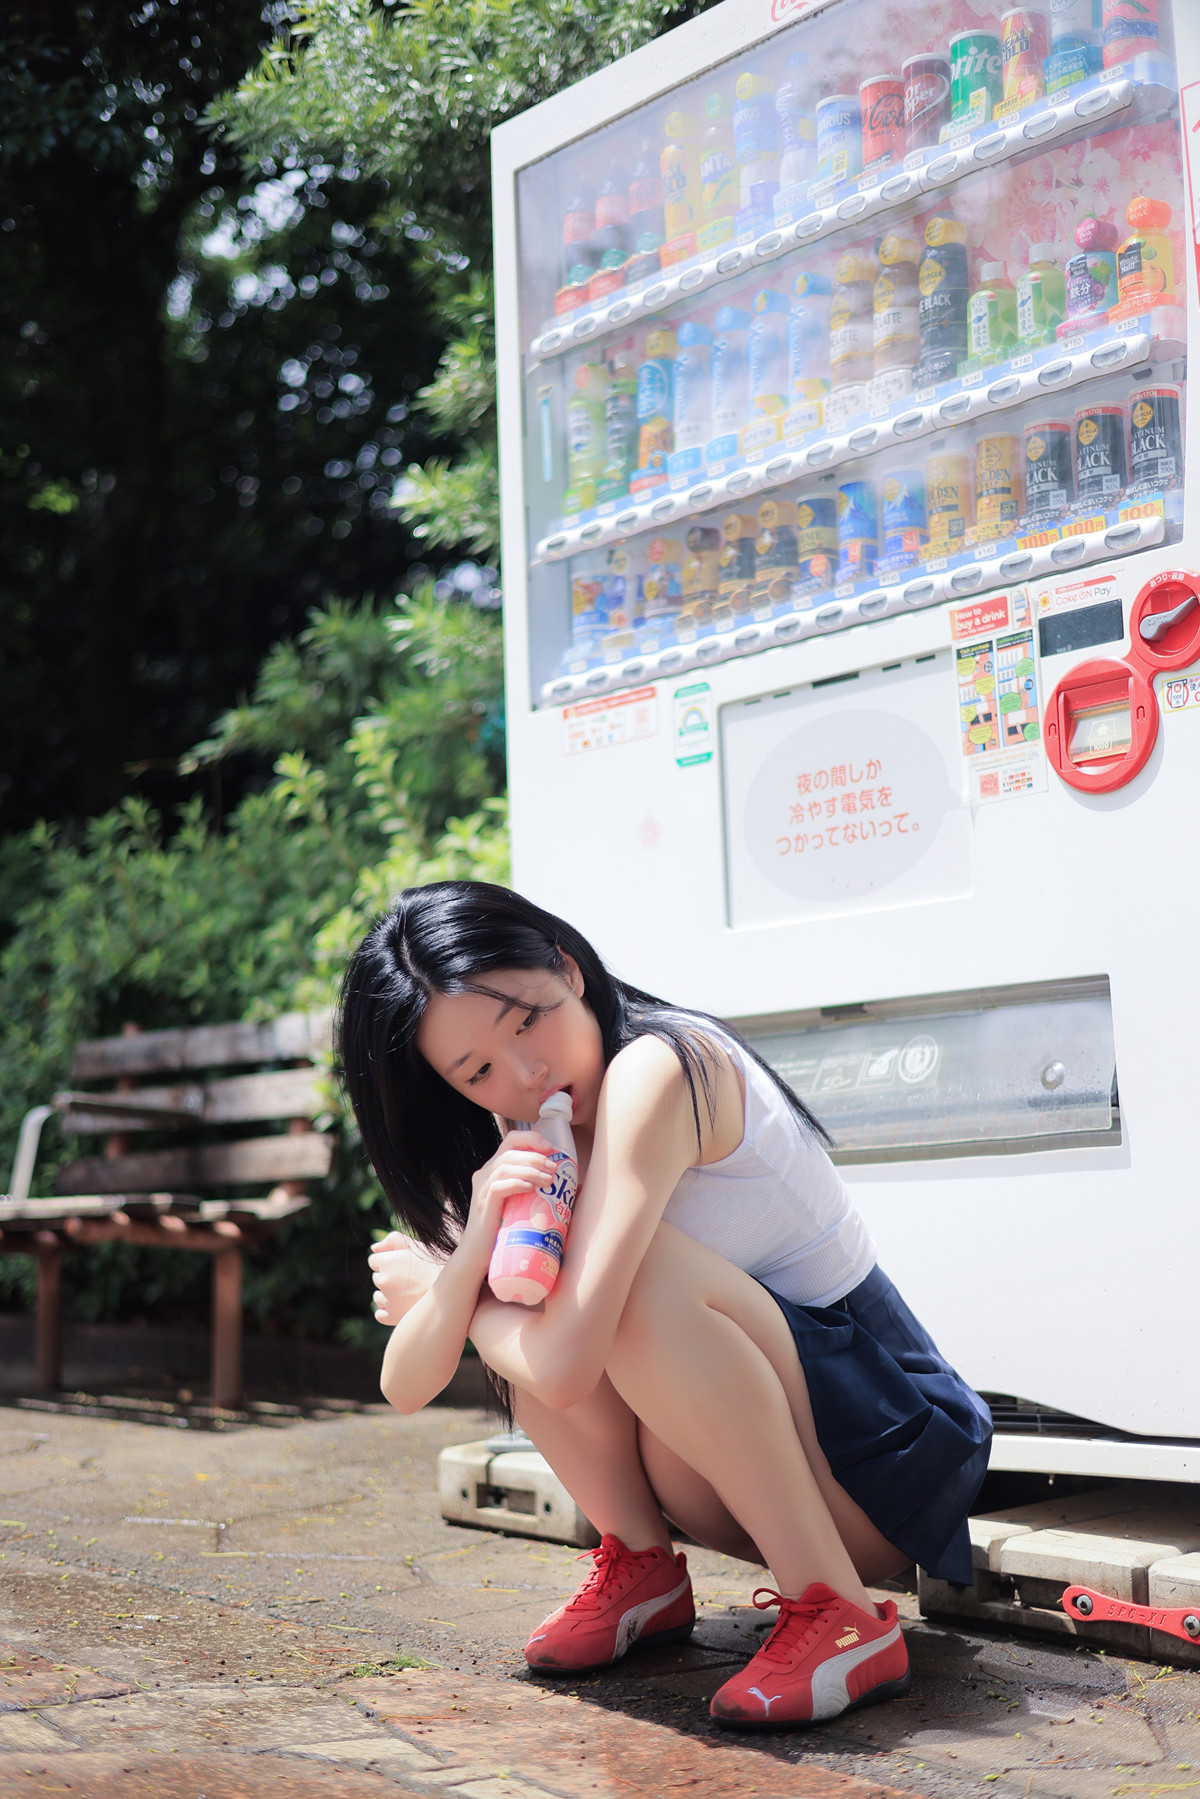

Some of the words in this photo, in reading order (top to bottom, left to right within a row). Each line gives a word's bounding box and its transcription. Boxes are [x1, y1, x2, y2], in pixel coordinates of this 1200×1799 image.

[950, 46, 1001, 84] rite
[818, 112, 851, 132] ARIUS
[1117, 319, 1136, 331] ¥150
[1120, 502, 1162, 522] 100円
[1066, 519, 1104, 537] 100円
[1019, 532, 1057, 549] 100円
[1055, 593, 1077, 605] Coke
[1094, 586, 1112, 597] Pay
[955, 610, 973, 621] How
[973, 607, 982, 616] to
[956, 619, 974, 632] buy
[974, 617, 981, 626] a
[981, 609, 1006, 624] drink
[796, 758, 883, 795] 夜の間しか
[788, 786, 893, 826] 冷やす電気を
[776, 812, 920, 857] つかってないって。
[835, 1631, 860, 1649] PUMA
